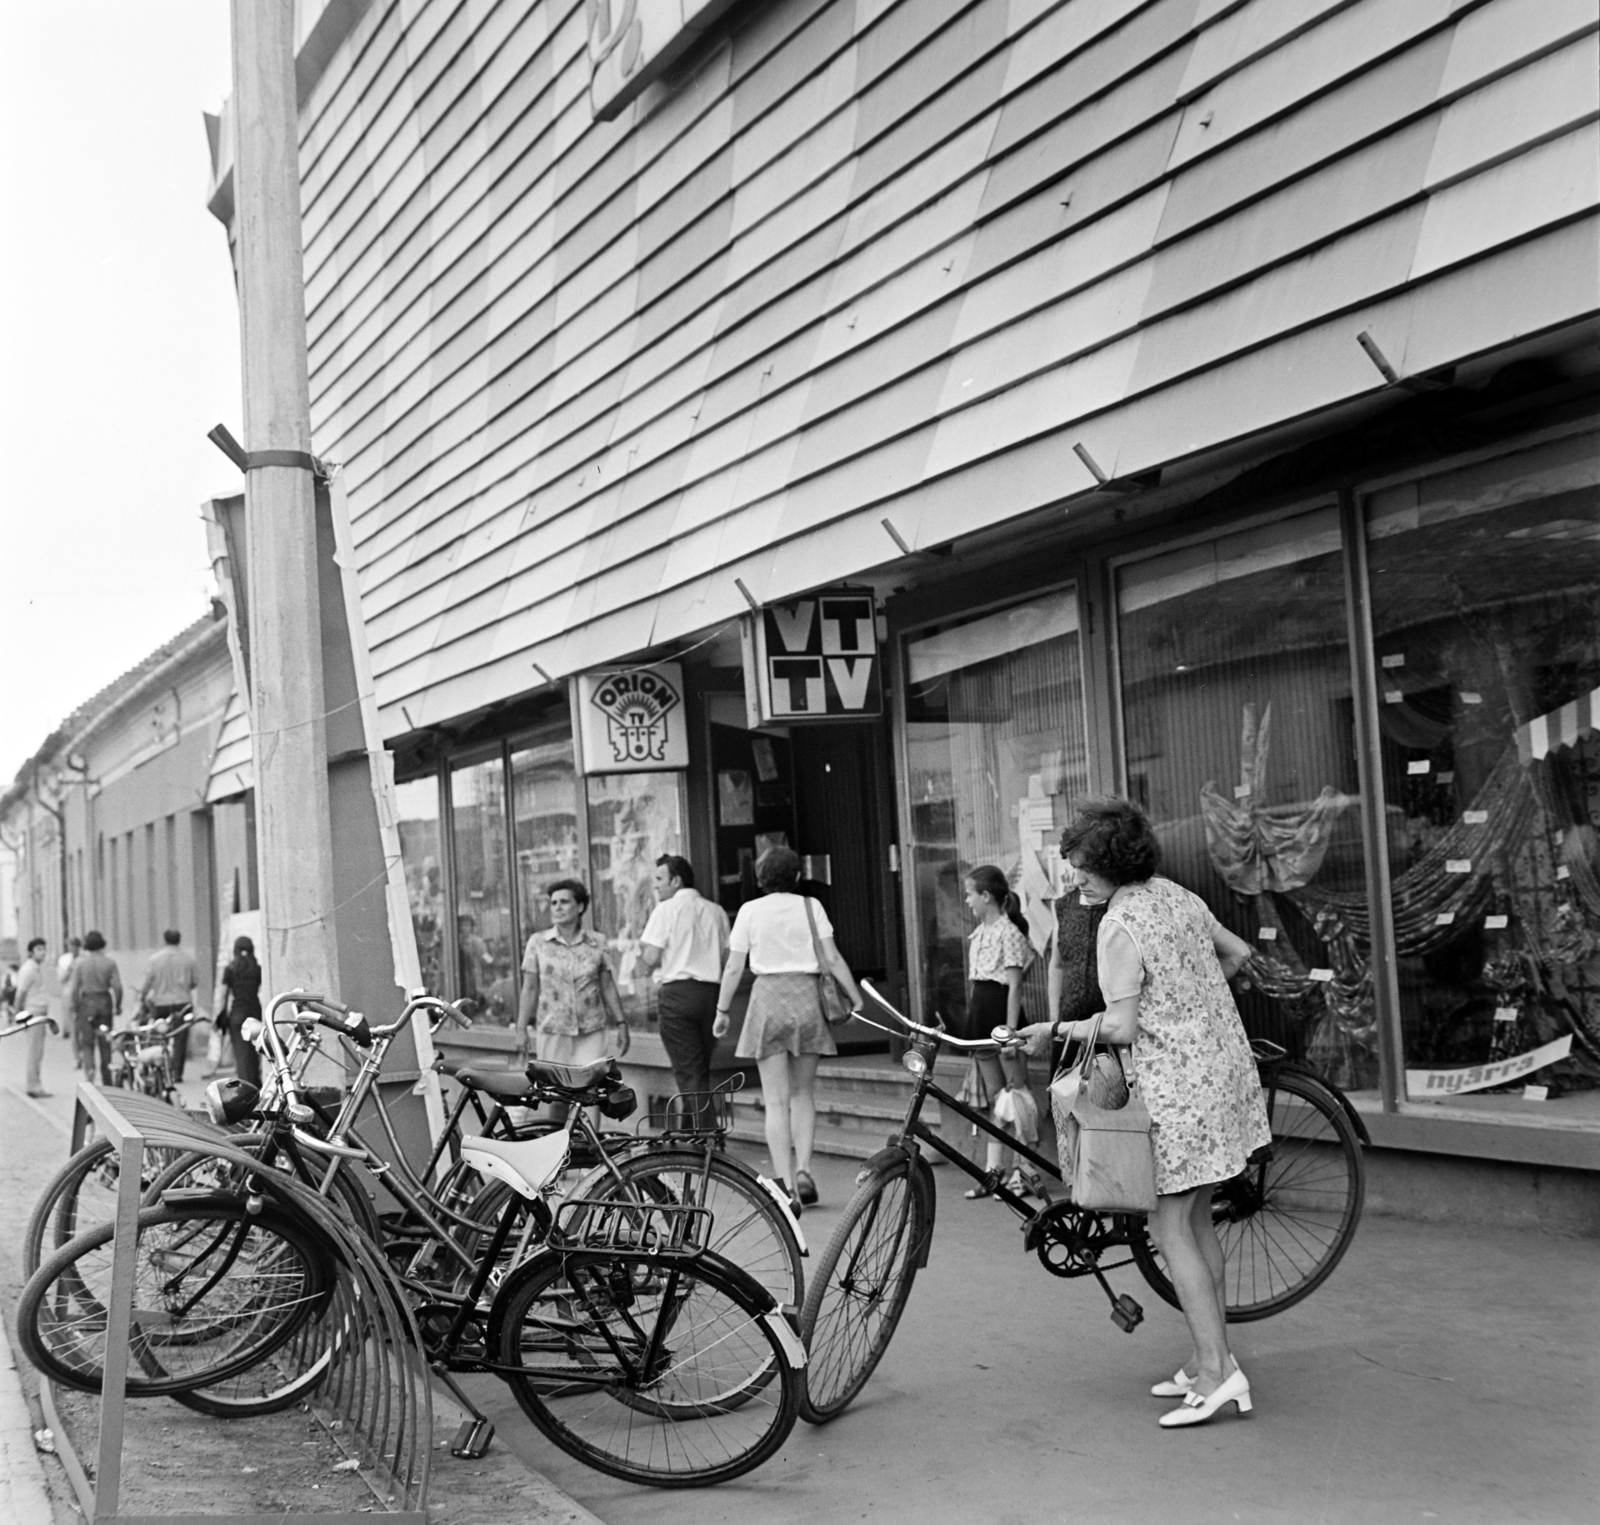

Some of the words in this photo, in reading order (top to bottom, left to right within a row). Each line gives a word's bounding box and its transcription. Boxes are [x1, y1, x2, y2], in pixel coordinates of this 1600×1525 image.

[771, 600, 870, 651] VT
[600, 674, 673, 708] ORION
[773, 658, 872, 711] TV
[629, 712, 645, 725] TV
